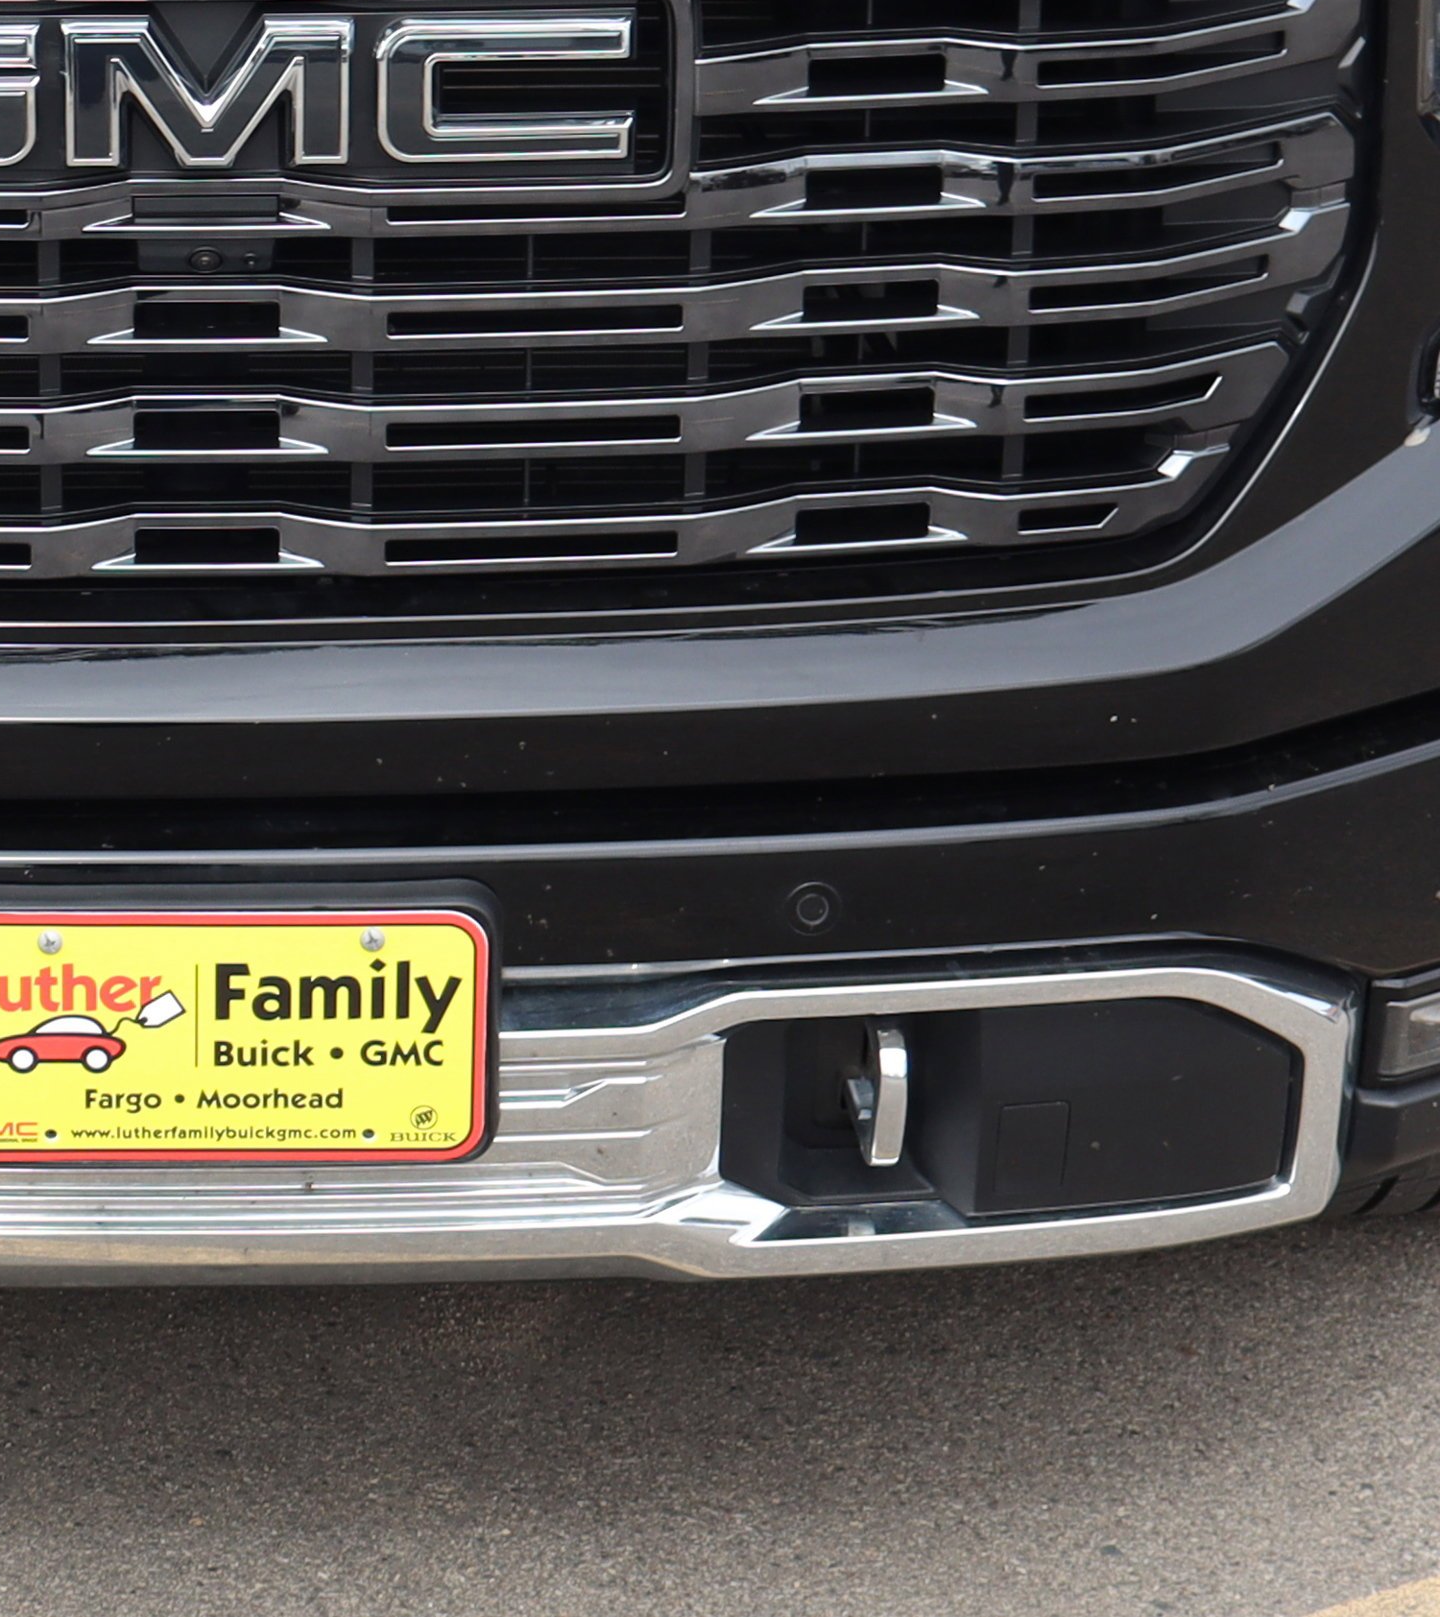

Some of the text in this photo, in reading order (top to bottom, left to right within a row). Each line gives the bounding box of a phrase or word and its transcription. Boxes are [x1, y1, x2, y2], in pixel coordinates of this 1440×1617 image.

[215, 958, 463, 1034] Family
[213, 1039, 444, 1067] Buick GMC
[84, 1087, 344, 1114] Fargo Moorhead
[71, 1126, 357, 1142] www.lutherfamilybuickgmc.com
[390, 1131, 457, 1143] BUICK
